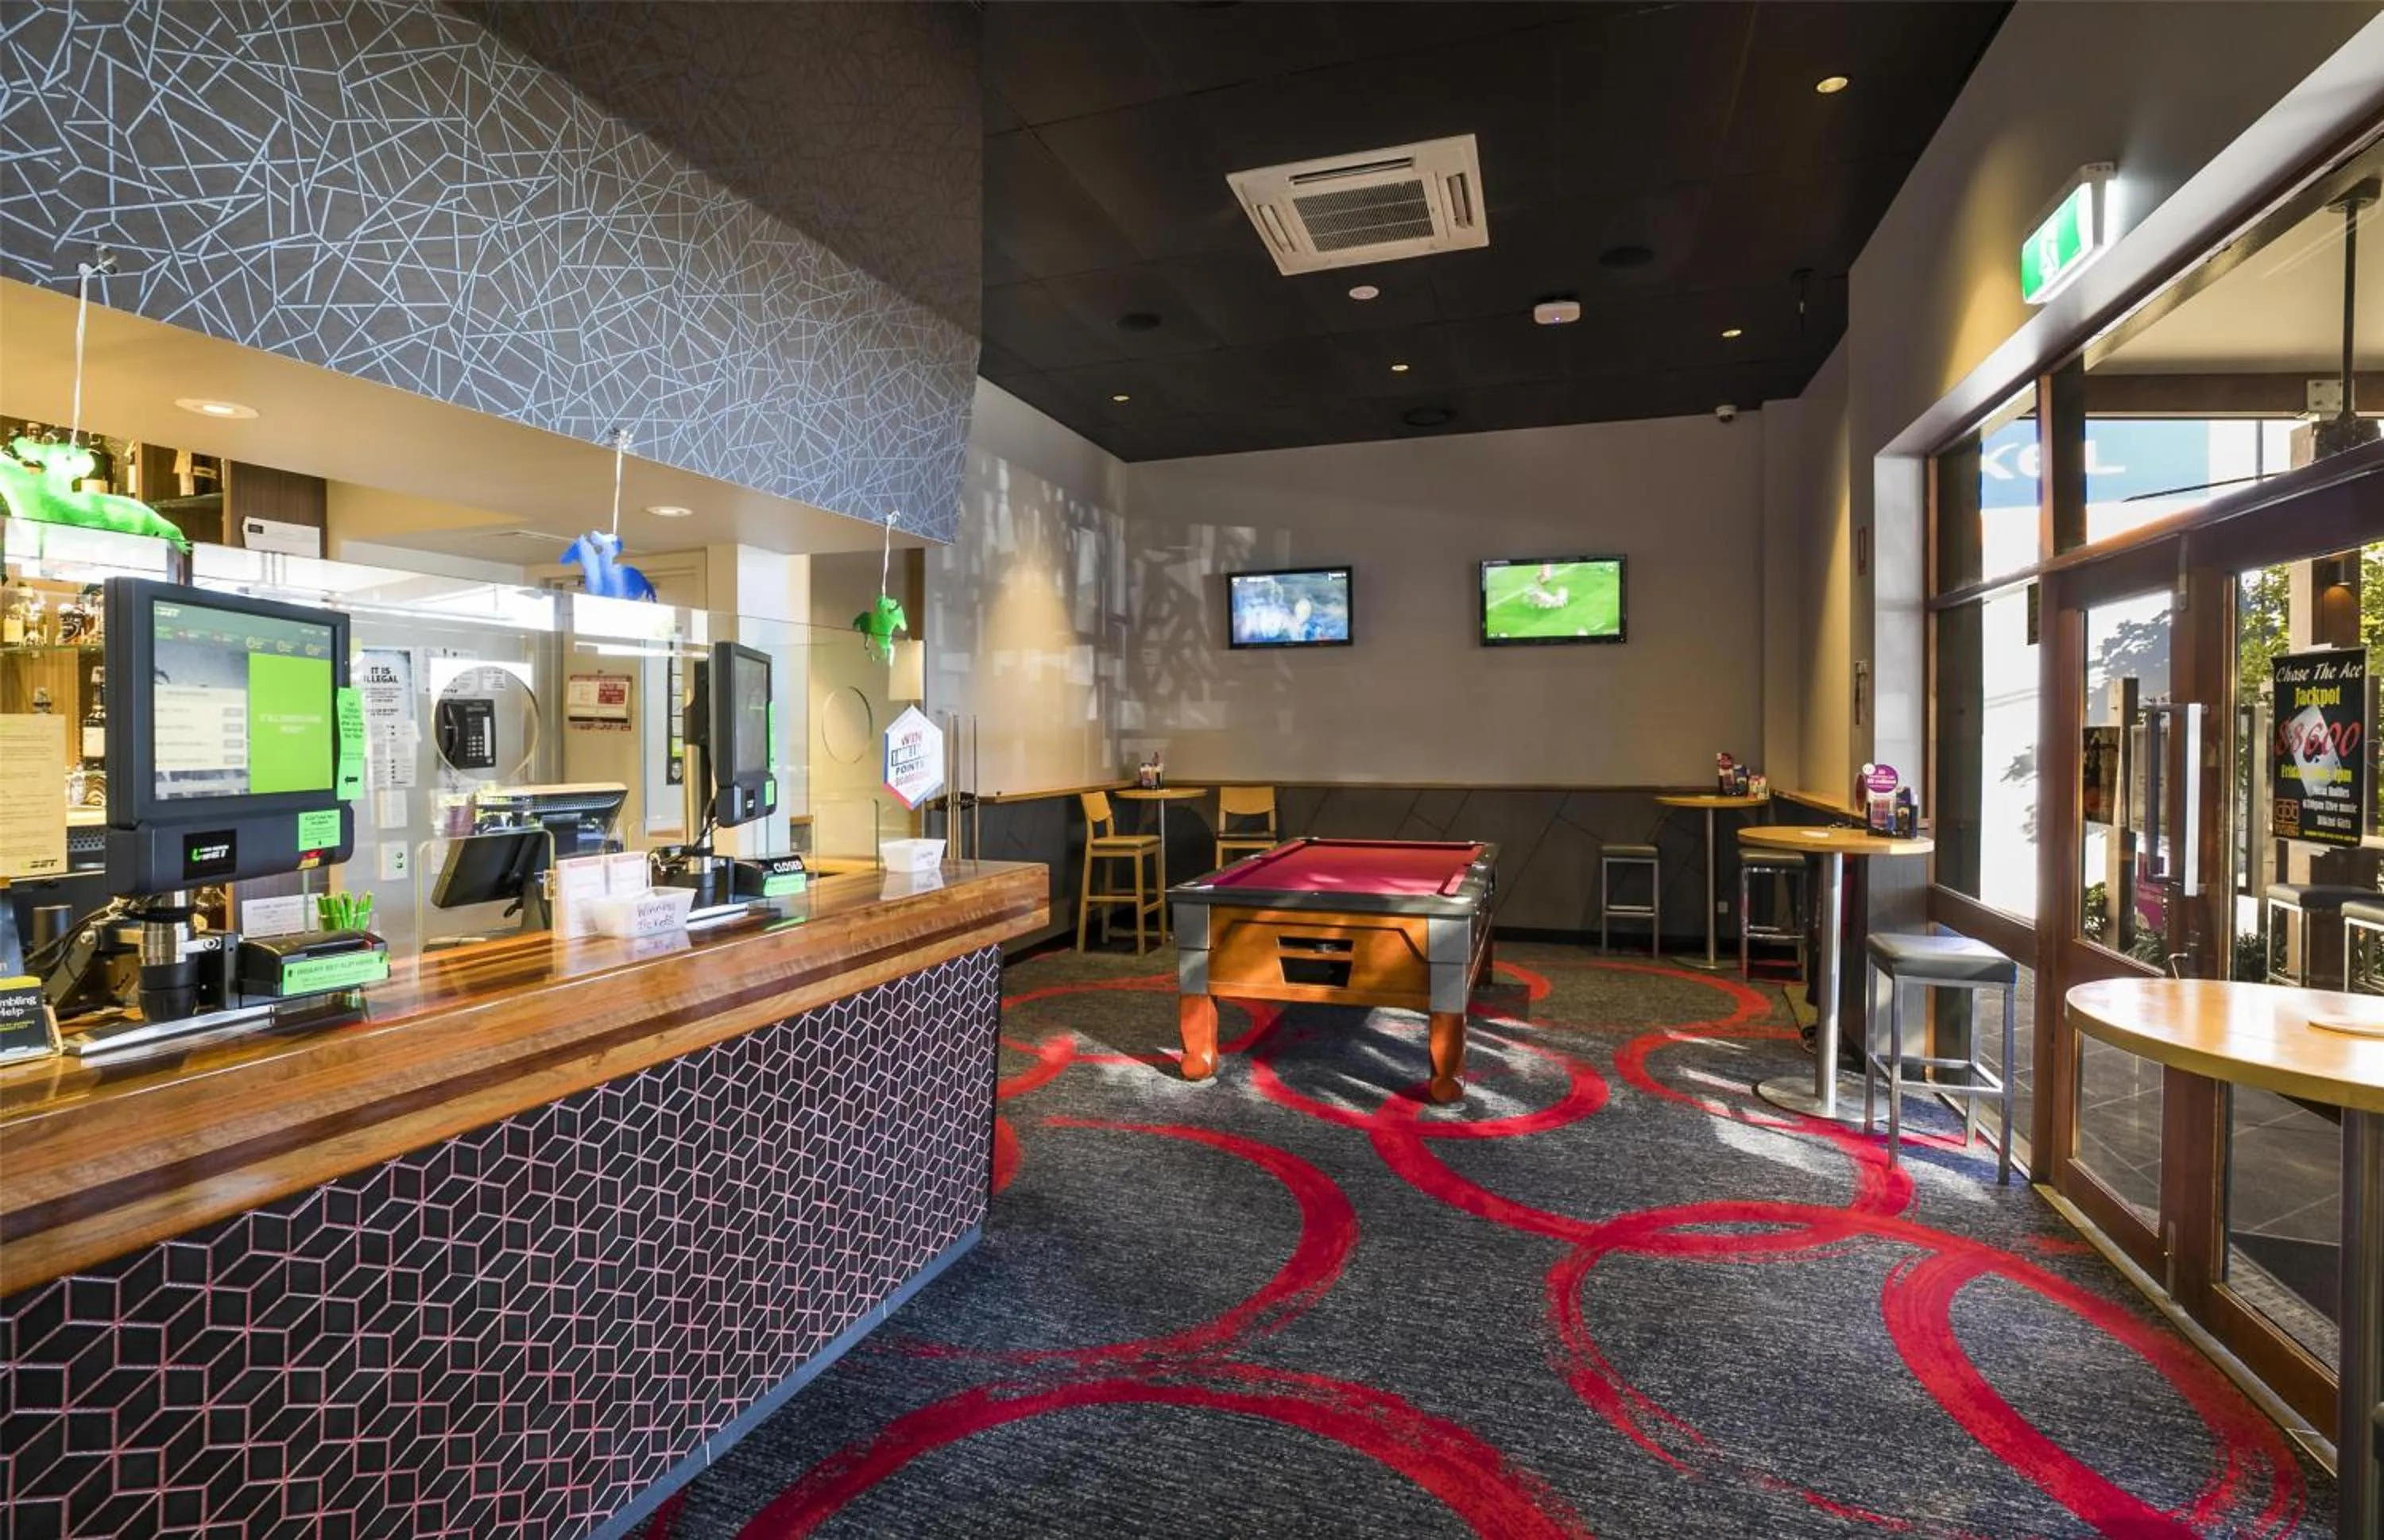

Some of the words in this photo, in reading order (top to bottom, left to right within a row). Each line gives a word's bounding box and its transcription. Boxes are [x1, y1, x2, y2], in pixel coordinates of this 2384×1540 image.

[363, 675, 399, 683] ILLEGAL
[2276, 664, 2309, 683] Chase
[2313, 662, 2337, 680] The
[2339, 661, 2363, 679] Ace
[2295, 687, 2339, 708] Jackpot
[773, 861, 803, 873] CLOSED
